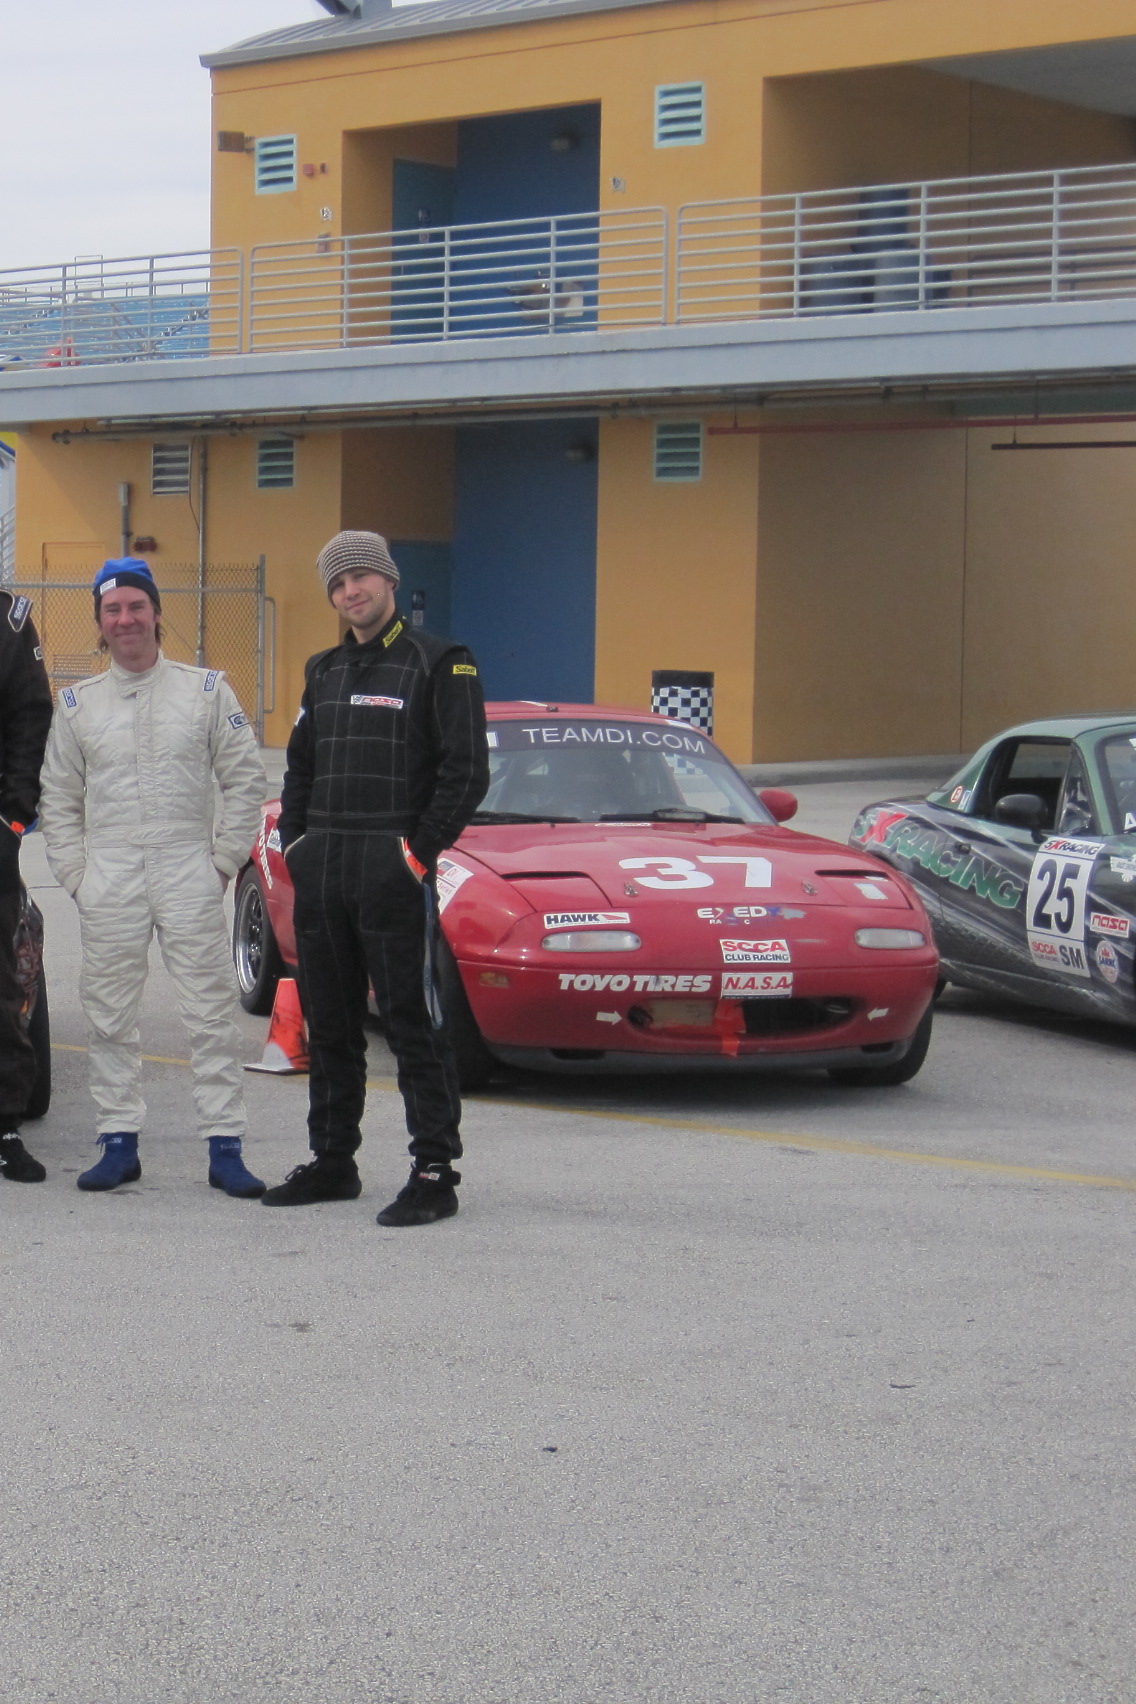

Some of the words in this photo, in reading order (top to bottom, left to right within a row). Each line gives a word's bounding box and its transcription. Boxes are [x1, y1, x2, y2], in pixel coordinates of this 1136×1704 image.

[522, 727, 706, 754] TEAMDI.COM
[618, 856, 773, 890] 37
[1032, 858, 1082, 935] 25
[546, 914, 600, 925] HAWK
[1091, 914, 1129, 931] nasa
[722, 940, 787, 954] SCCA
[1032, 941, 1058, 955] SCCA
[724, 953, 752, 962] CLUB
[753, 953, 790, 962] RACING
[1059, 944, 1085, 970] SM
[558, 973, 631, 992] TOYO
[633, 974, 713, 992] TIRES
